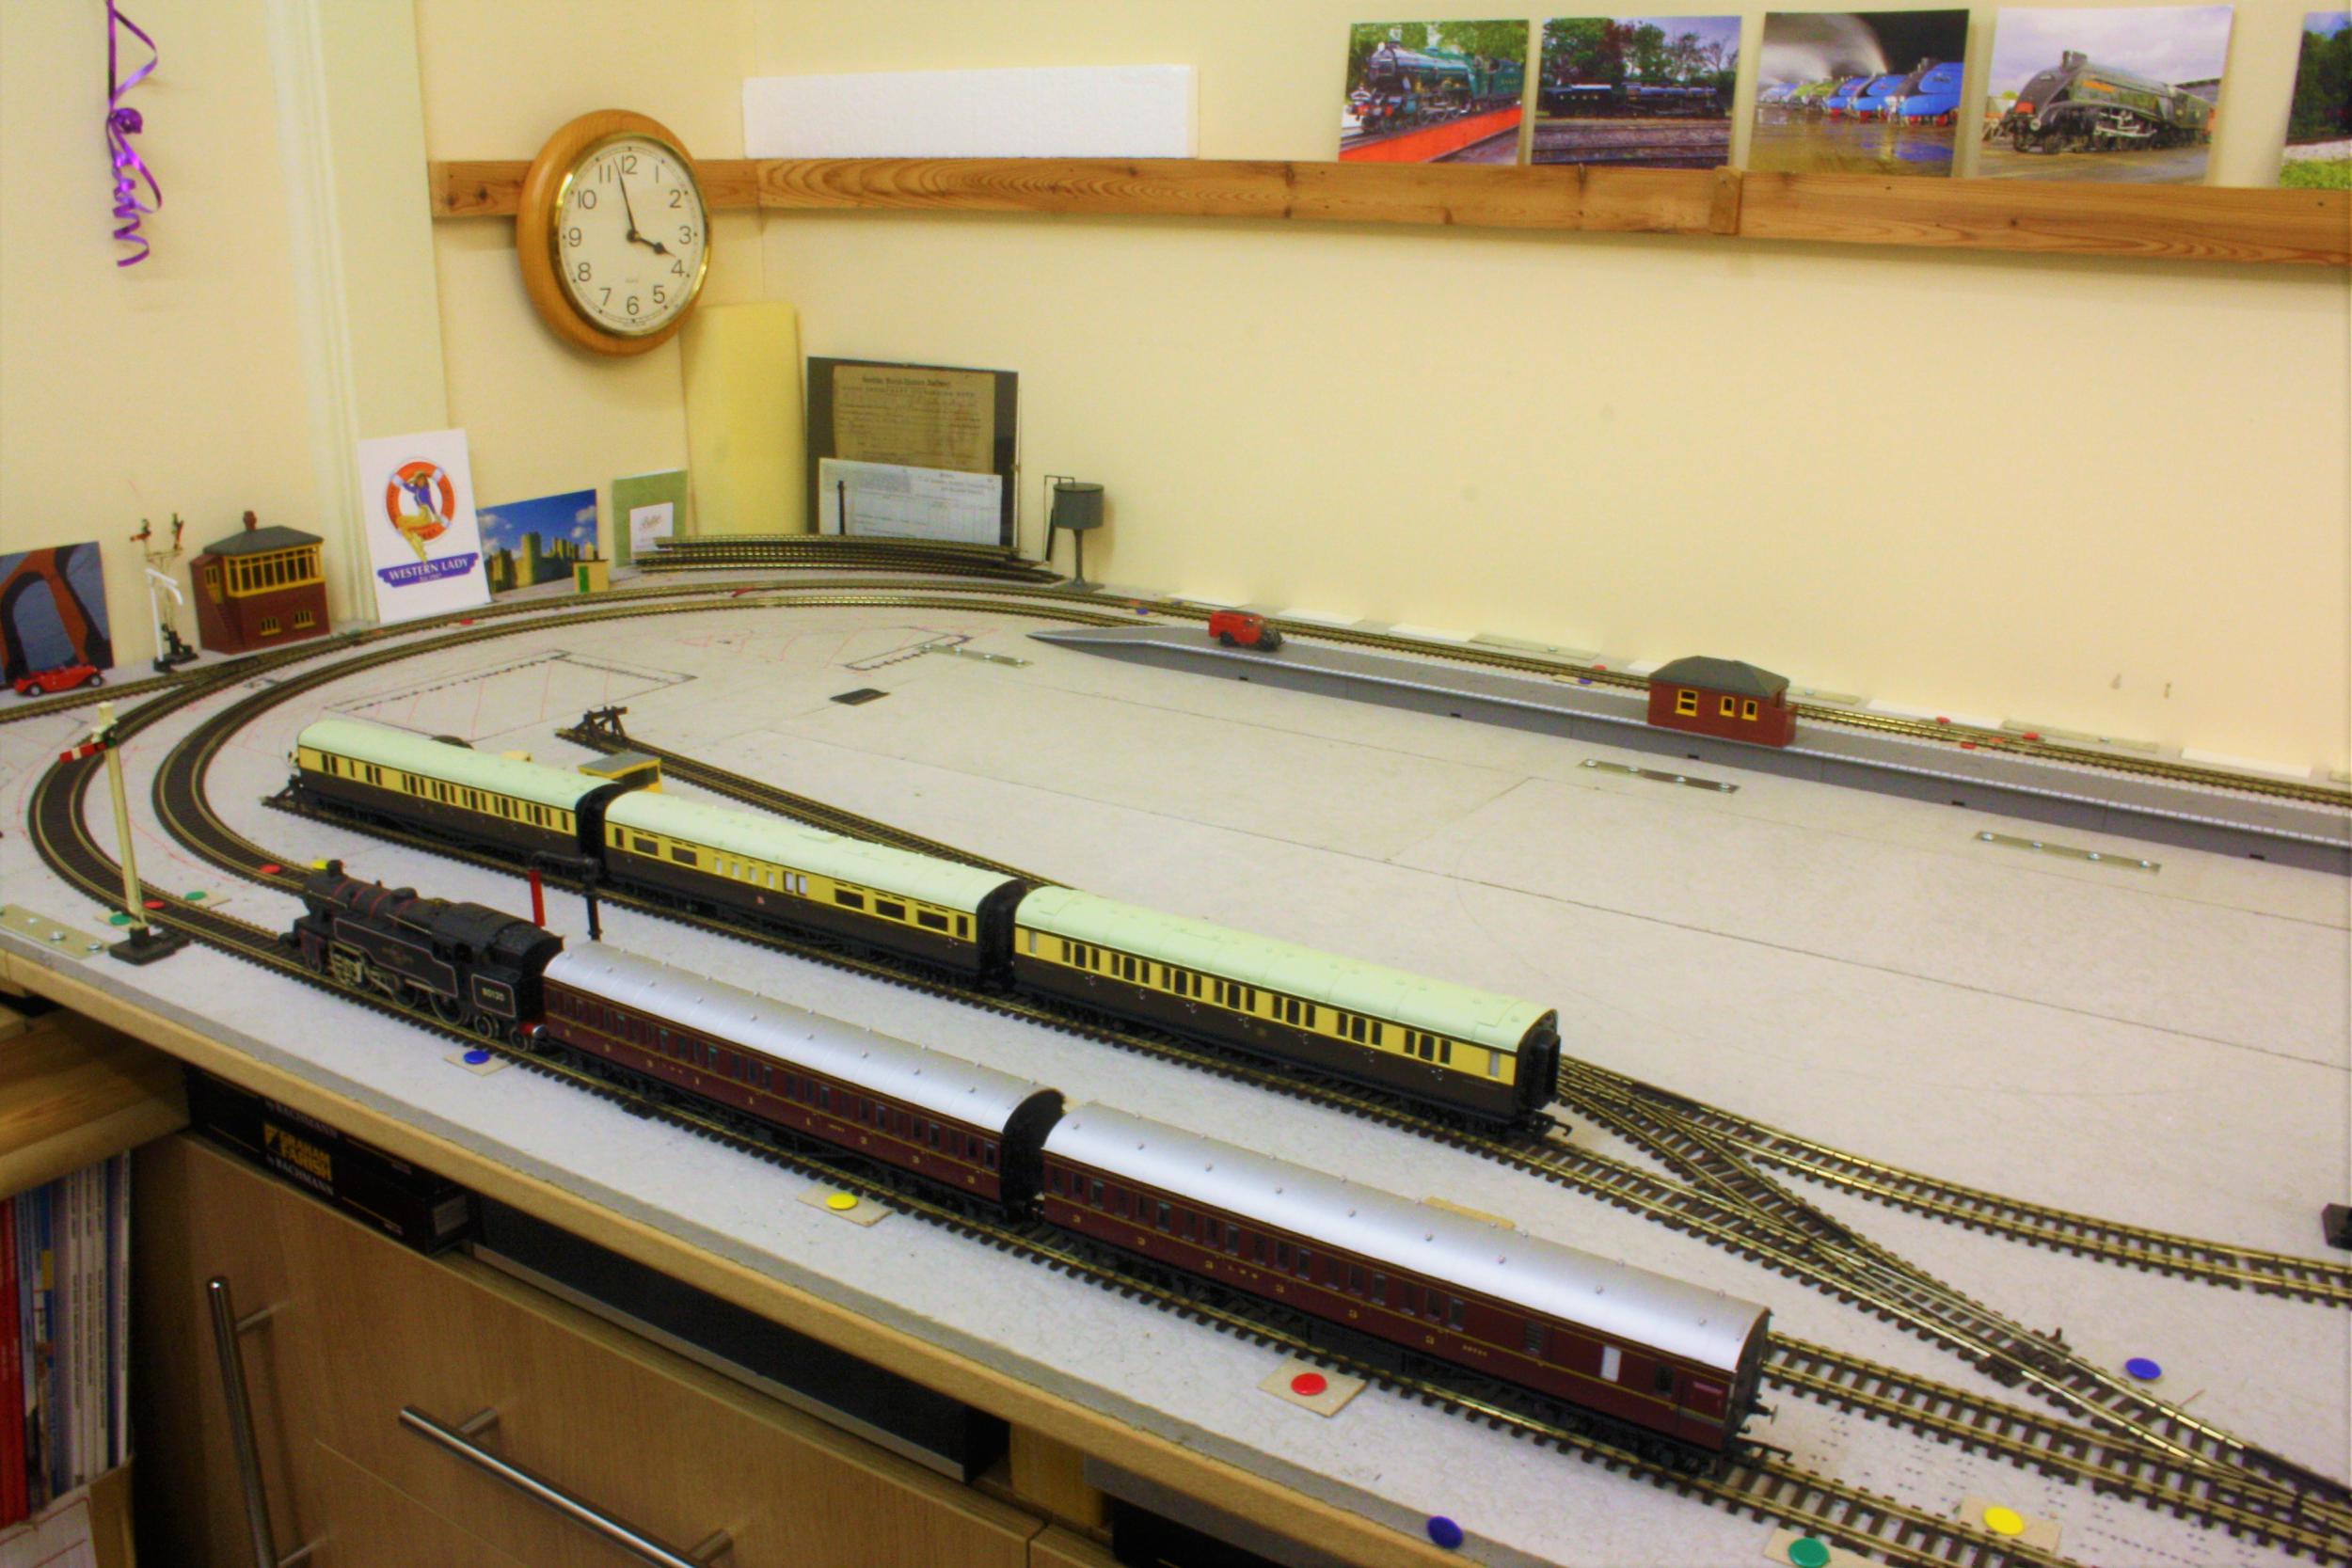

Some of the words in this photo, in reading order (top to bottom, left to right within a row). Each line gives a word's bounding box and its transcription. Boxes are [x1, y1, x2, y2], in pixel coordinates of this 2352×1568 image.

[599, 165, 612, 183] 11
[620, 155, 638, 175] 12
[577, 190, 597, 210] 10
[669, 189, 682, 208] 2
[568, 228, 582, 246] 9
[678, 226, 692, 245] 3
[578, 261, 592, 282] 8
[671, 260, 686, 277] 4
[598, 287, 612, 306] 7
[652, 285, 666, 304] 5
[626, 296, 640, 315] 6
[389, 563, 438, 580] WESTERN
[440, 557, 469, 572] LADY
